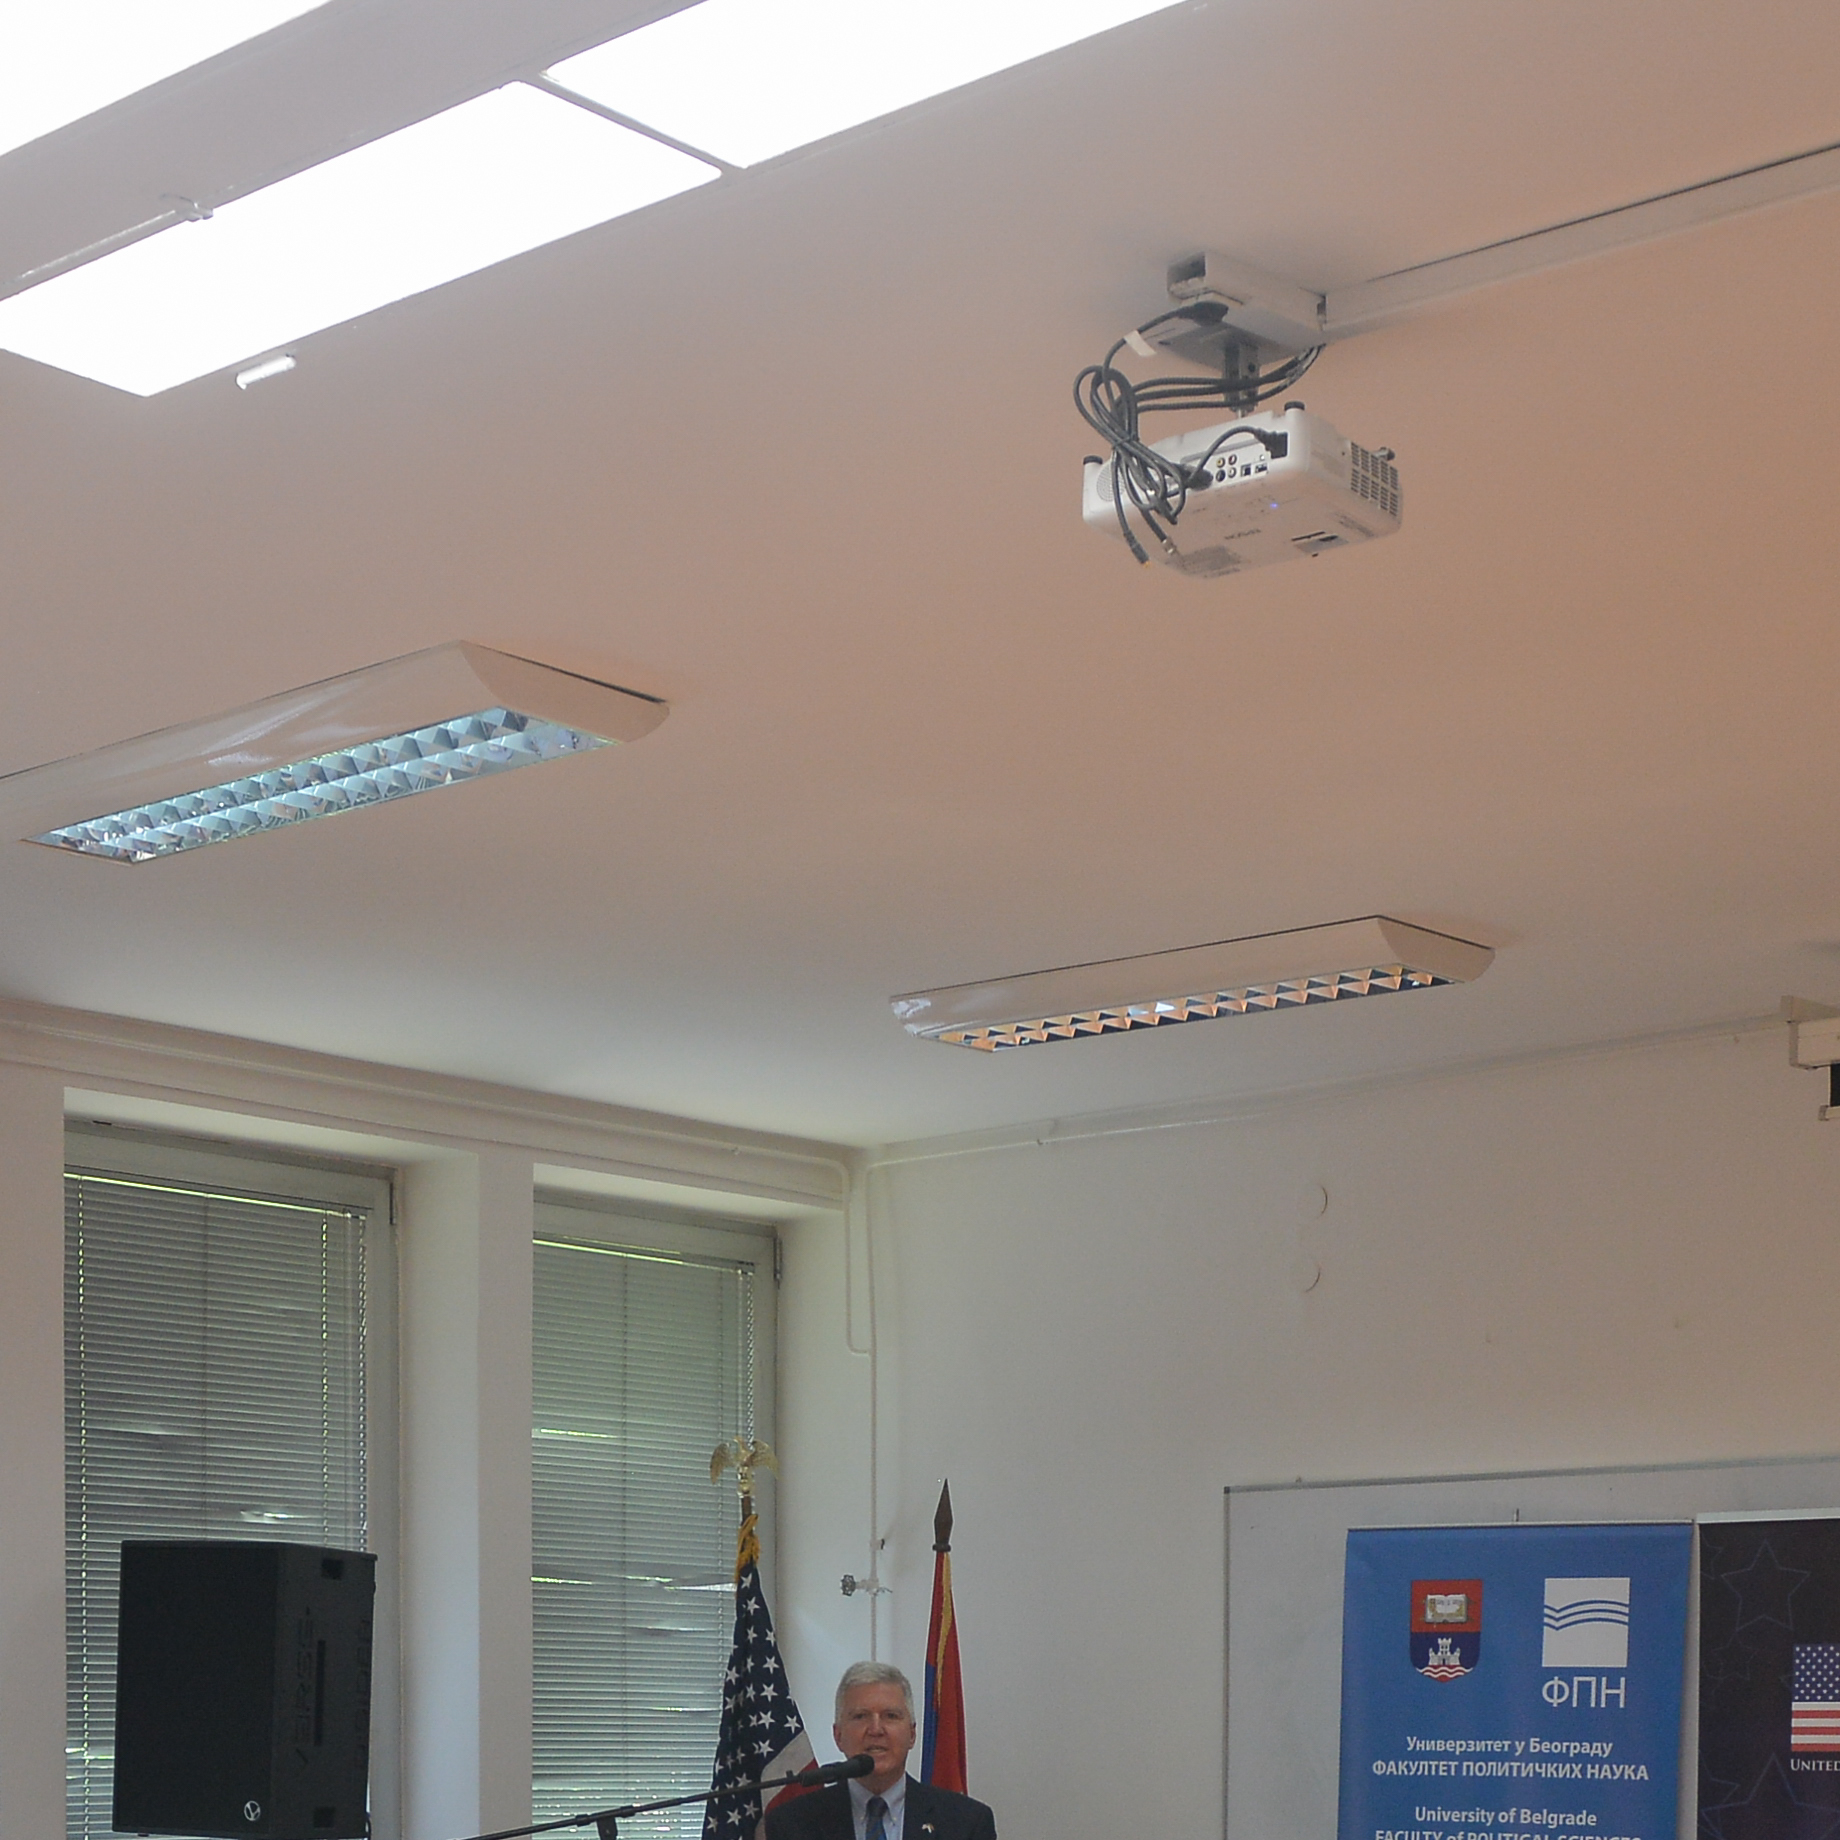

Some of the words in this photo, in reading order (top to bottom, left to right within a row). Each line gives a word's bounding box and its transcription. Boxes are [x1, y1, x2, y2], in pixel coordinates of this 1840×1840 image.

[1542, 1676, 1626, 1708] ФПН
[1406, 1736, 1510, 1755] Универзитет
[1515, 1742, 1525, 1756] у
[1530, 1738, 1613, 1757] Београду
[1372, 1760, 1458, 1776] ФАКУЛТЕТ
[1462, 1762, 1582, 1779] ПОЛИТИЧКИХ
[1587, 1765, 1649, 1780] НАУКА
[1415, 1807, 1495, 1826] University
[1498, 1808, 1516, 1823] of
[1520, 1808, 1597, 1828] Belgrade
